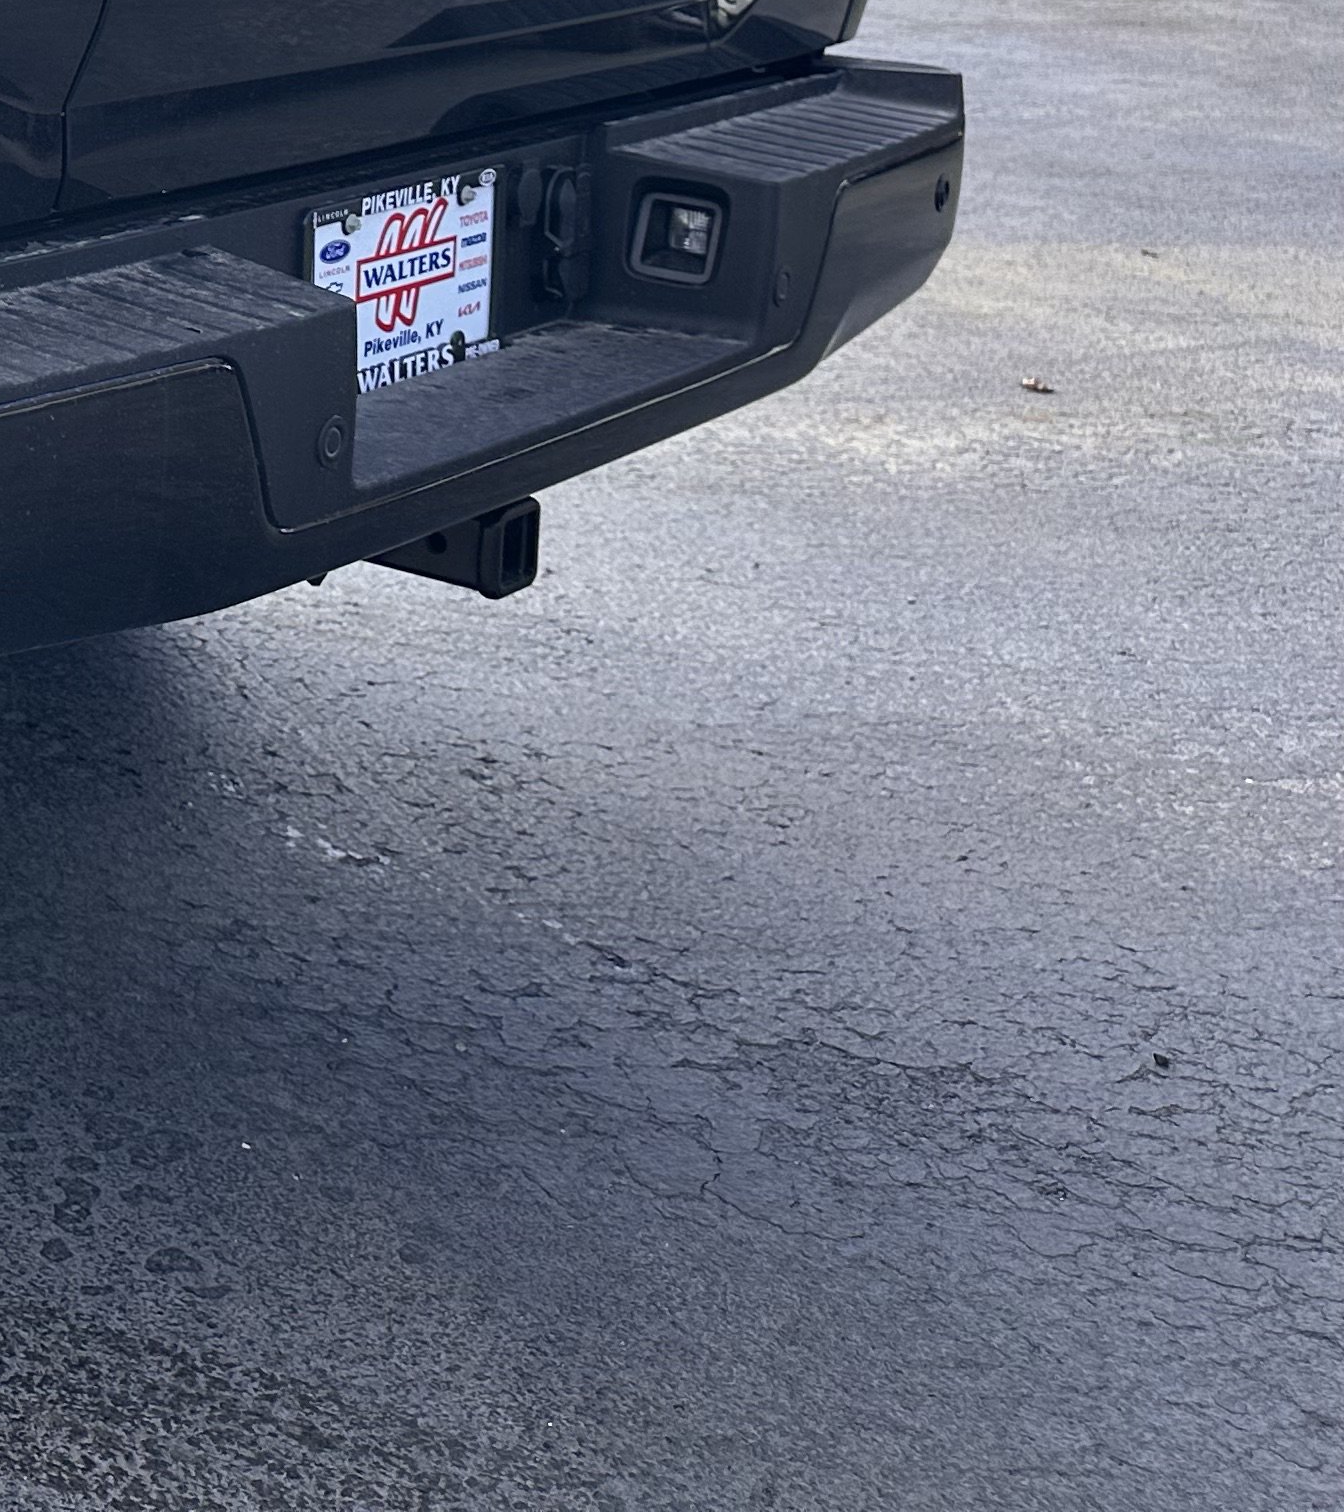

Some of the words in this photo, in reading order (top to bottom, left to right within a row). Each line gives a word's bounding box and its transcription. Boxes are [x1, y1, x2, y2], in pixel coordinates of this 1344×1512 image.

[362, 181, 437, 216] PIKEVILLE,
[440, 174, 461, 196] KY
[363, 248, 452, 289] WALTERS
[458, 278, 487, 294] NISSAN
[363, 330, 422, 358] Pikeville,
[425, 318, 444, 340] KY
[357, 344, 454, 394] WALTERS
